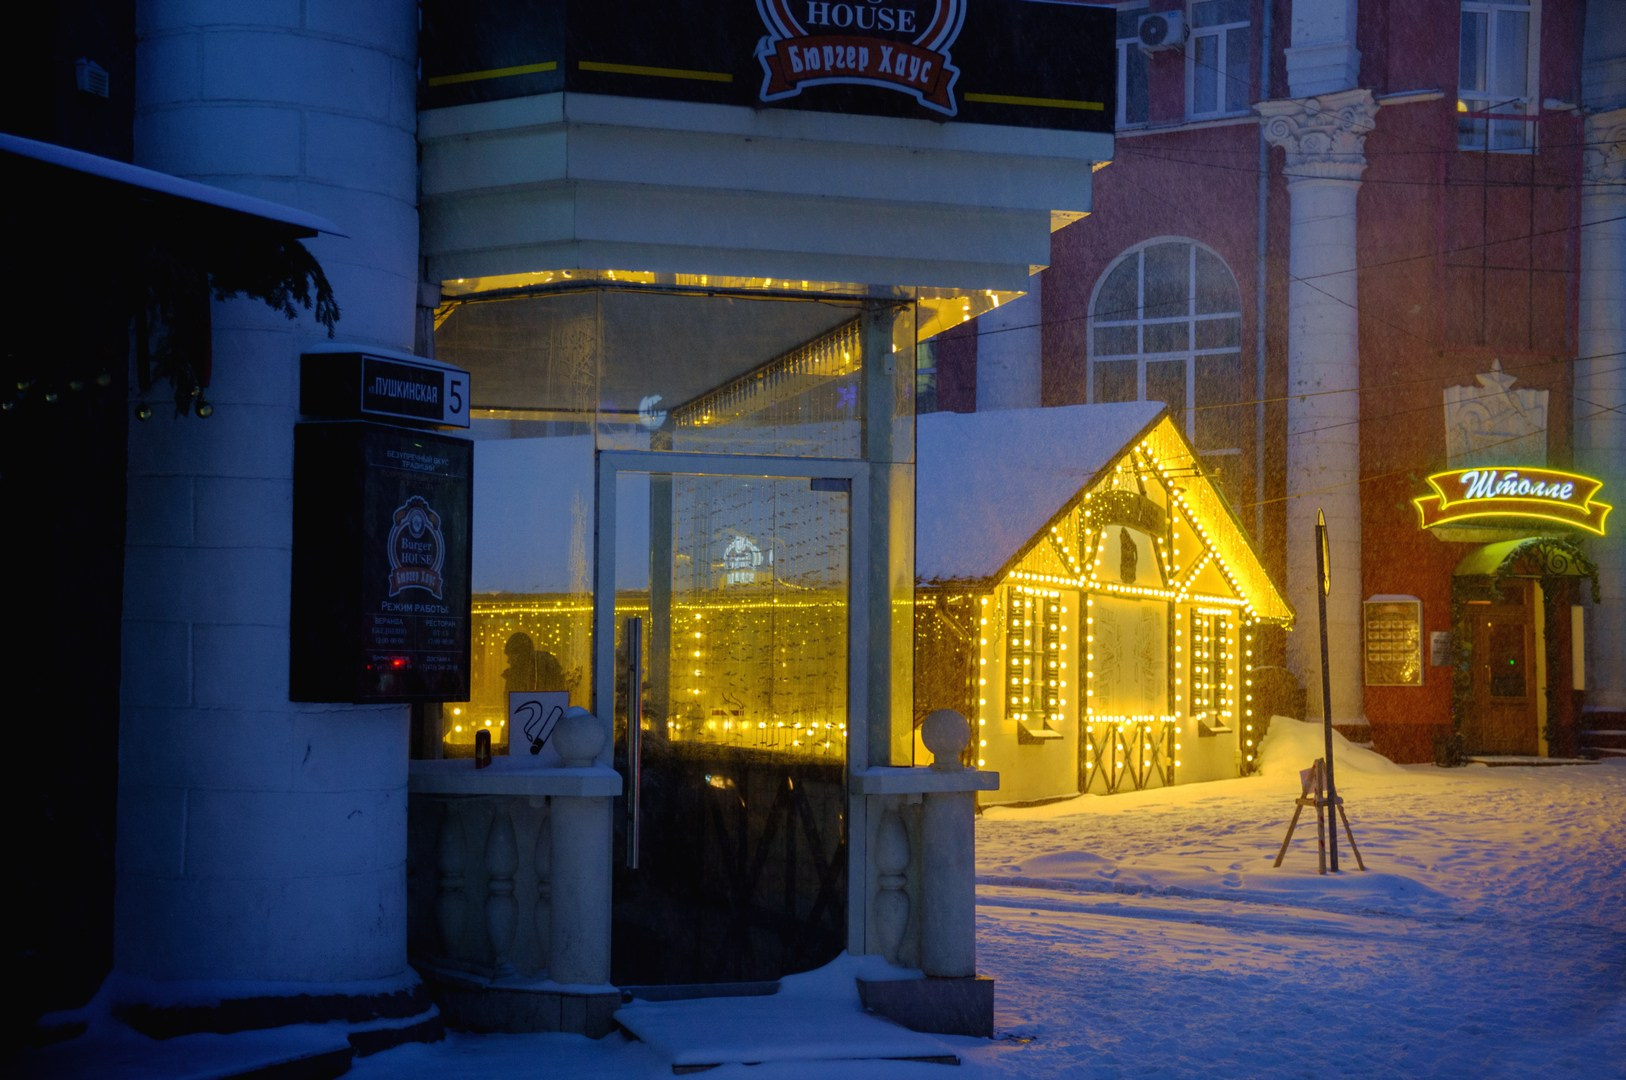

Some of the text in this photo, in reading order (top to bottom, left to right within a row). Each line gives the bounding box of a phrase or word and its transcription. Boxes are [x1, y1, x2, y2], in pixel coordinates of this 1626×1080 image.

[806, 1, 916, 33] HOUSE
[788, 45, 932, 84] Бюргер Хаус
[375, 376, 438, 404] ПУШКИНСКАЯ
[449, 379, 462, 414] 5
[1460, 469, 1574, 500] Штолле
[401, 538, 432, 554] Burger
[401, 552, 432, 565] HOUSE
